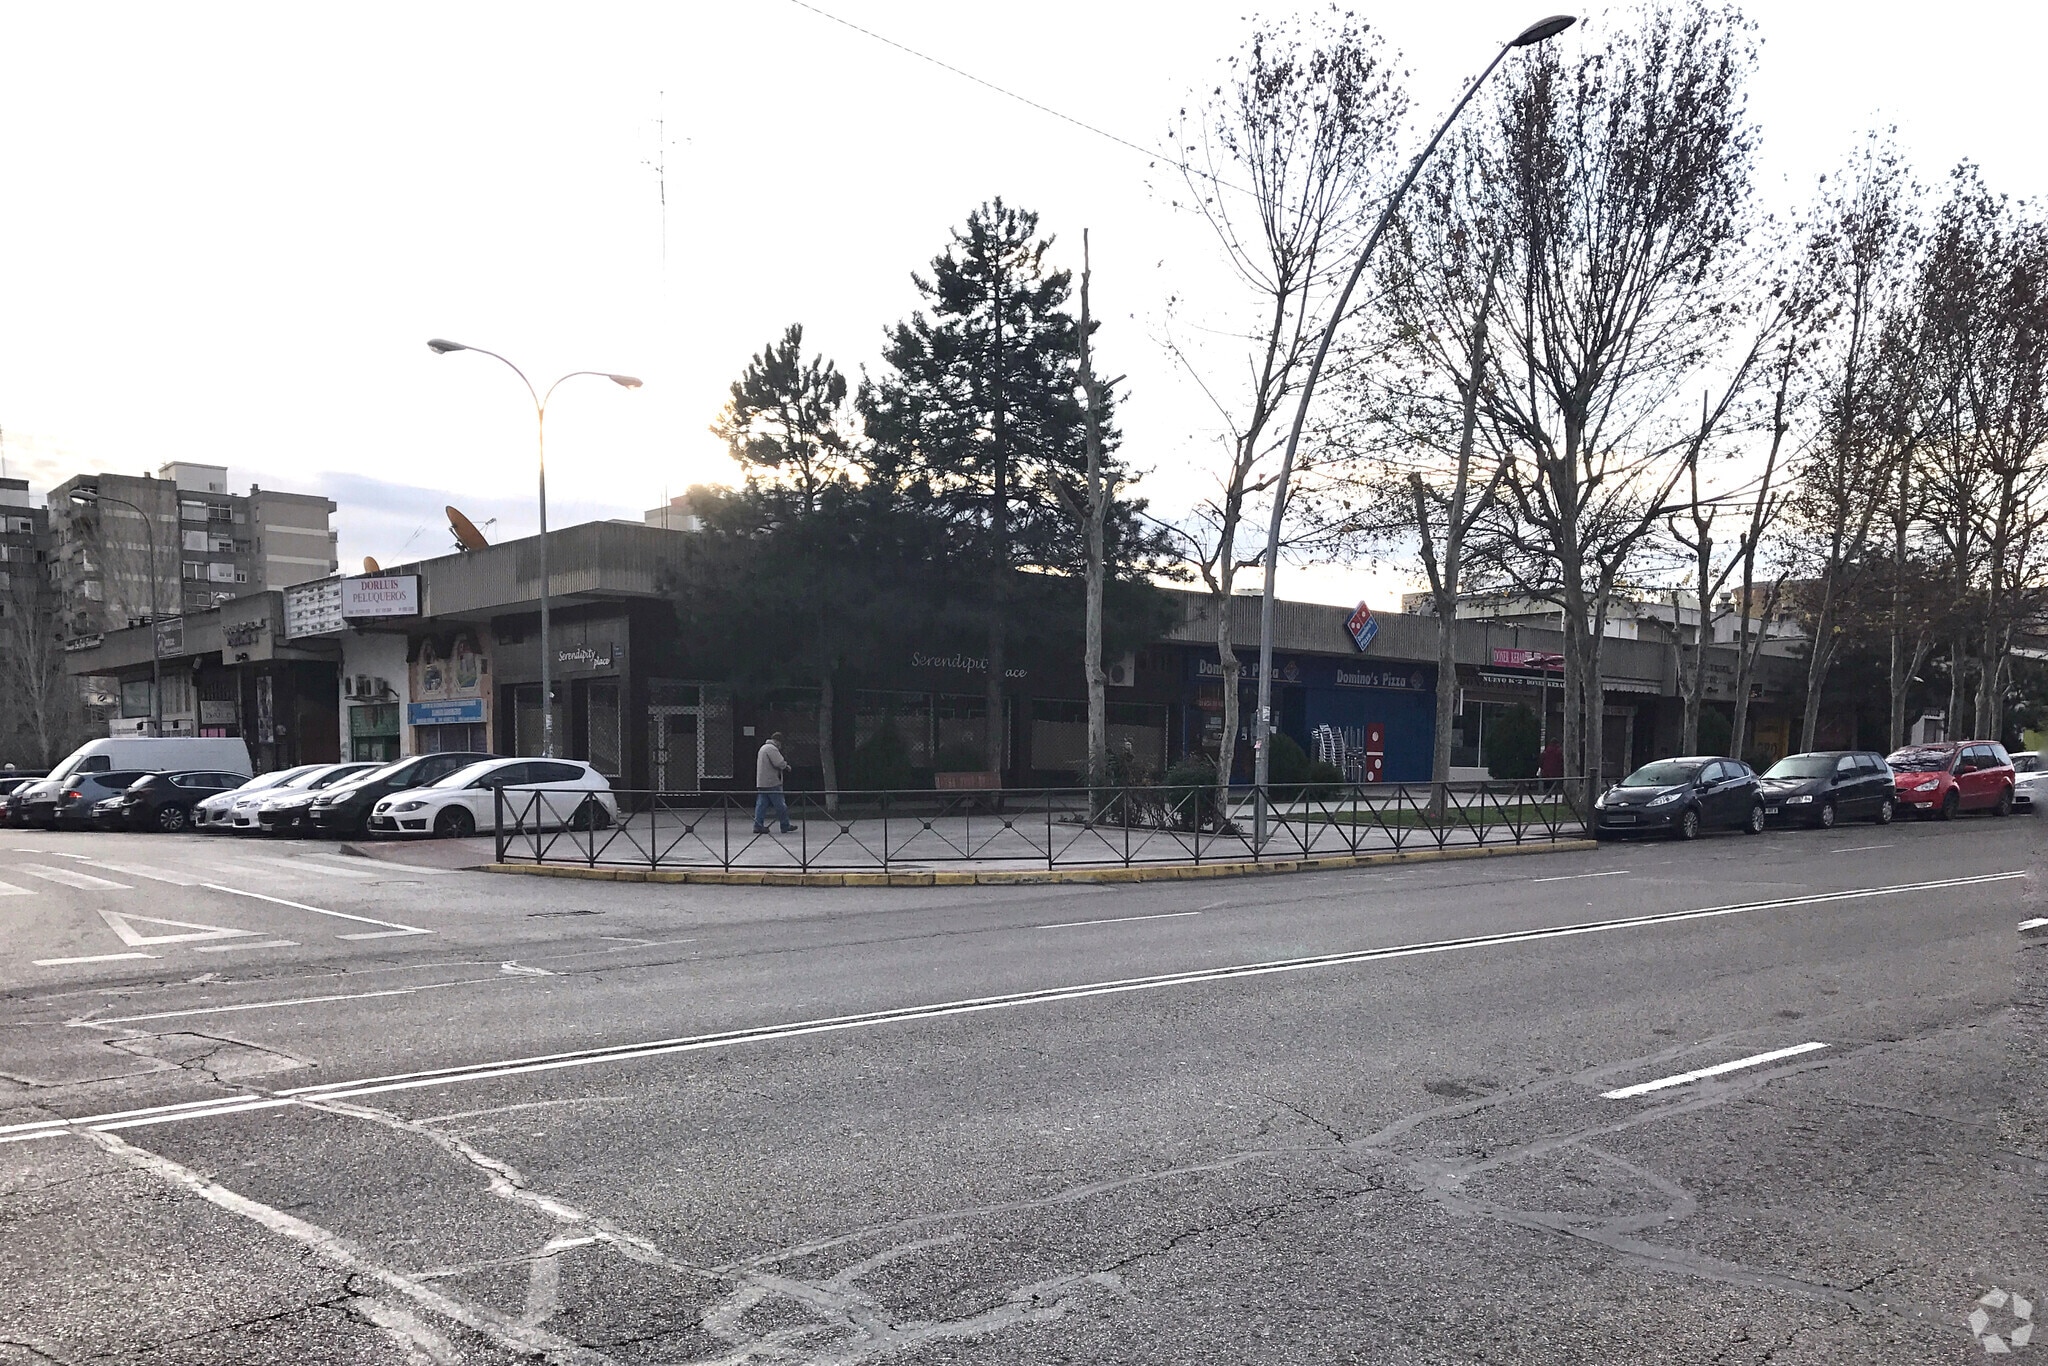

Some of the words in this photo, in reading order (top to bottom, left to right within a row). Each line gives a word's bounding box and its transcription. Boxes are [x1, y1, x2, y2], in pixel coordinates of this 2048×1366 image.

[361, 579, 399, 591] DORLUIS
[352, 590, 407, 604] PELUQUEROS
[558, 648, 596, 664] Serendipity
[593, 655, 611, 669] place
[911, 651, 989, 674] Serendipit
[1336, 669, 1379, 685] Domino's
[1382, 671, 1407, 687] Pizza
